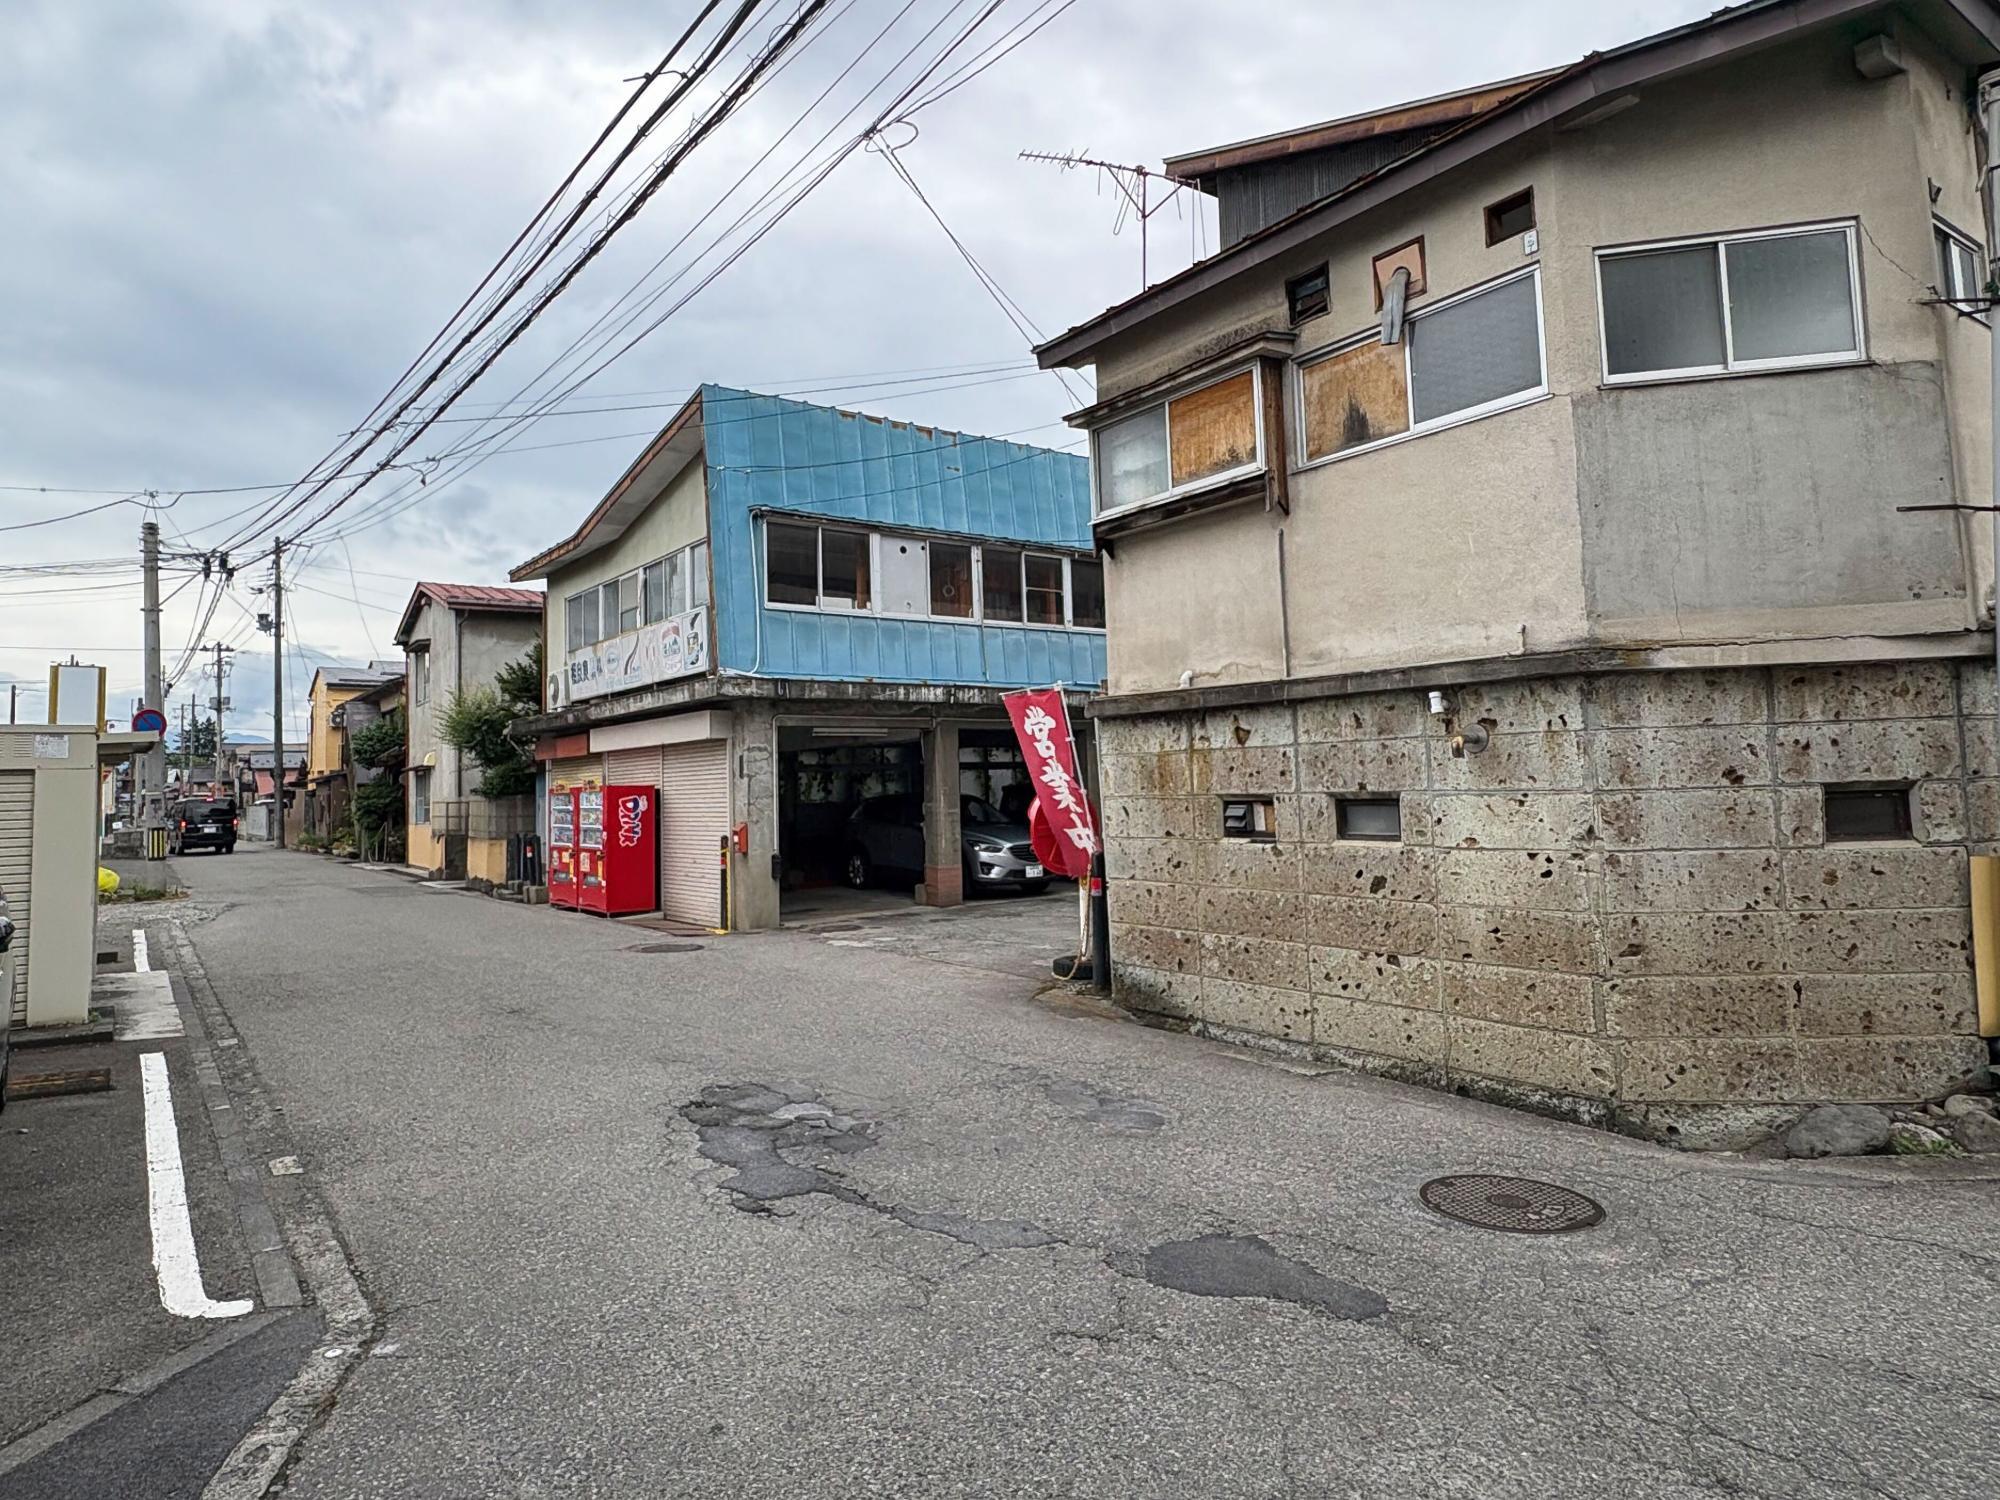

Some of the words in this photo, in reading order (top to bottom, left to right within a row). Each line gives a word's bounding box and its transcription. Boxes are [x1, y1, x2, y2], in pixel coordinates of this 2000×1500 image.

[619, 795, 642, 847] DRINK
[1024, 705, 1096, 857] 営業中
